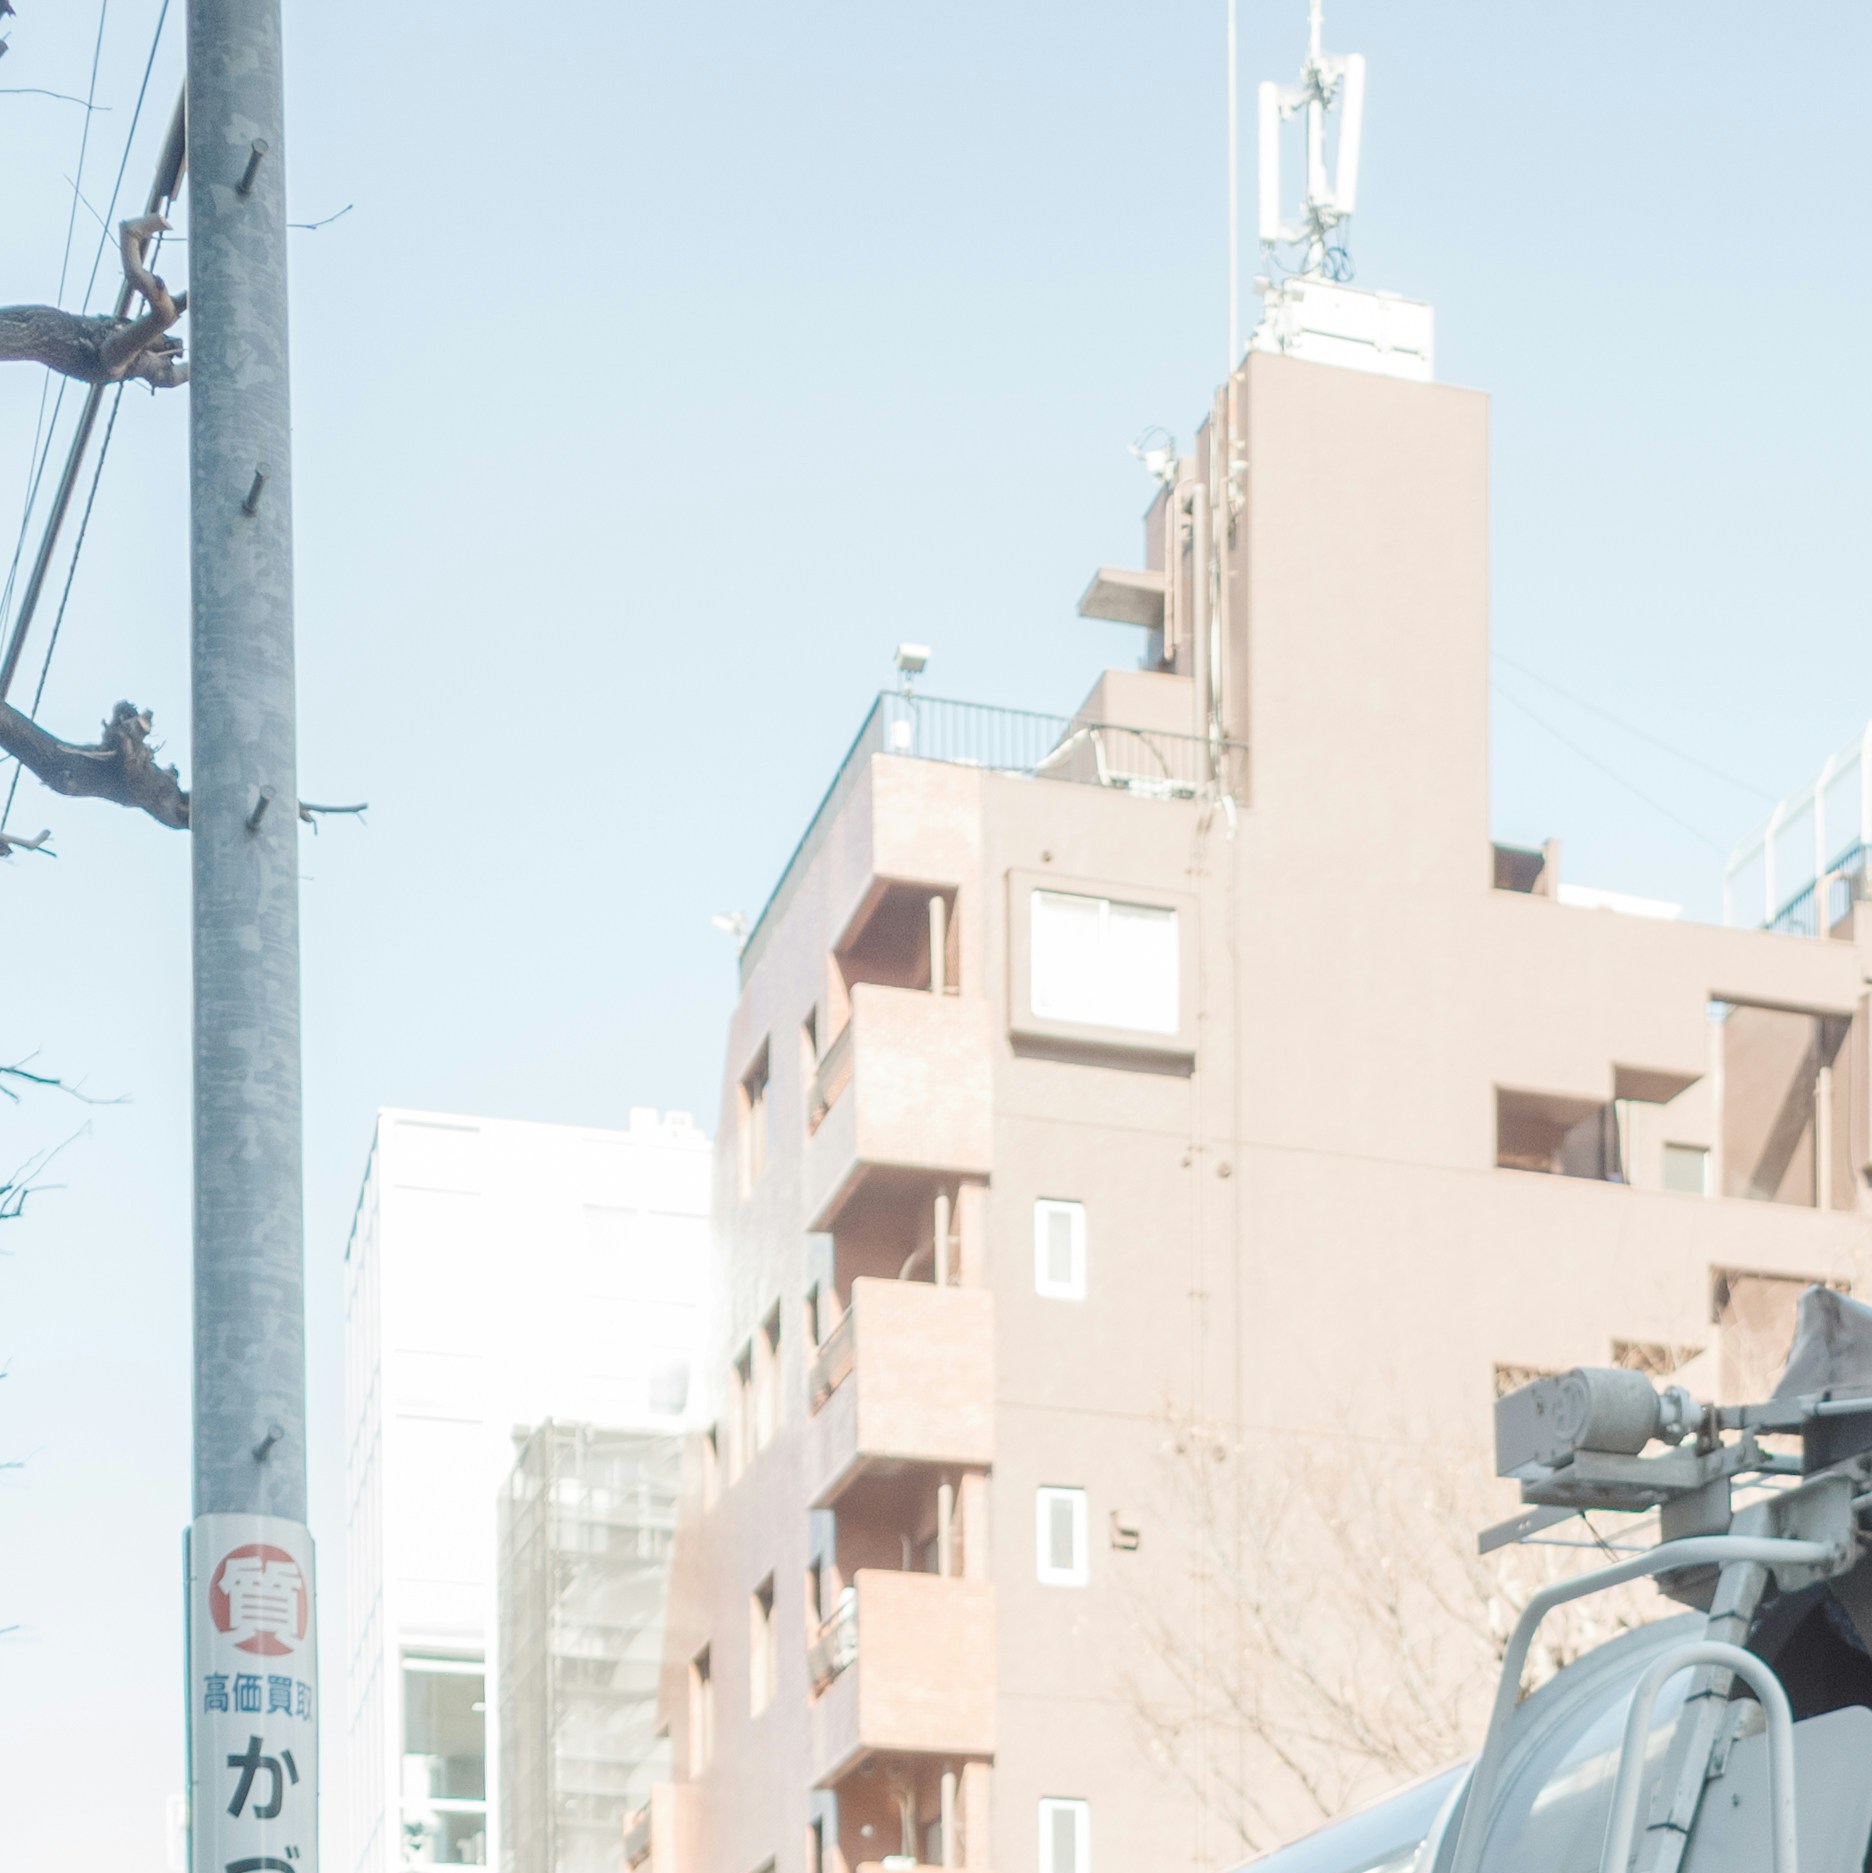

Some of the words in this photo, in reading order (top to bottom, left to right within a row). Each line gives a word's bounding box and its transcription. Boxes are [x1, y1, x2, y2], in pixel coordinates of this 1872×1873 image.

[217, 1556, 307, 1652] 質
[203, 1671, 314, 1723] 高価買取
